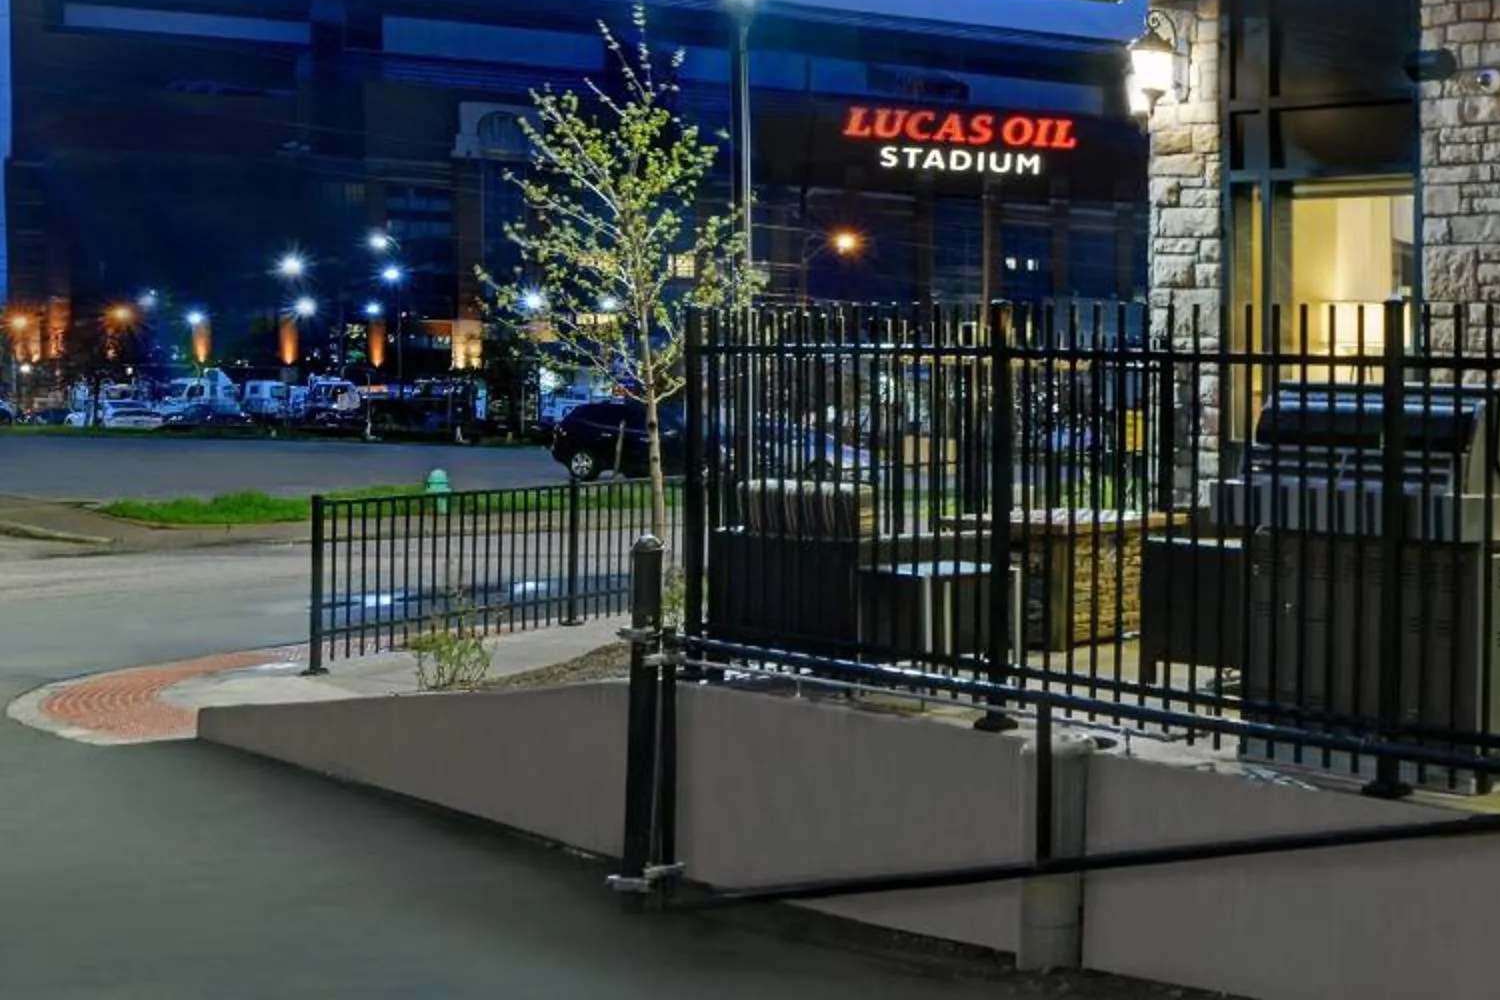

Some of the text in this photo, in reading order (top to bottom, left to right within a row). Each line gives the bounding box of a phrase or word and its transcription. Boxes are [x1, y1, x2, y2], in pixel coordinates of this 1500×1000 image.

[843, 107, 1077, 149] LUCAS OIL
[879, 145, 1042, 175] STADIUM
